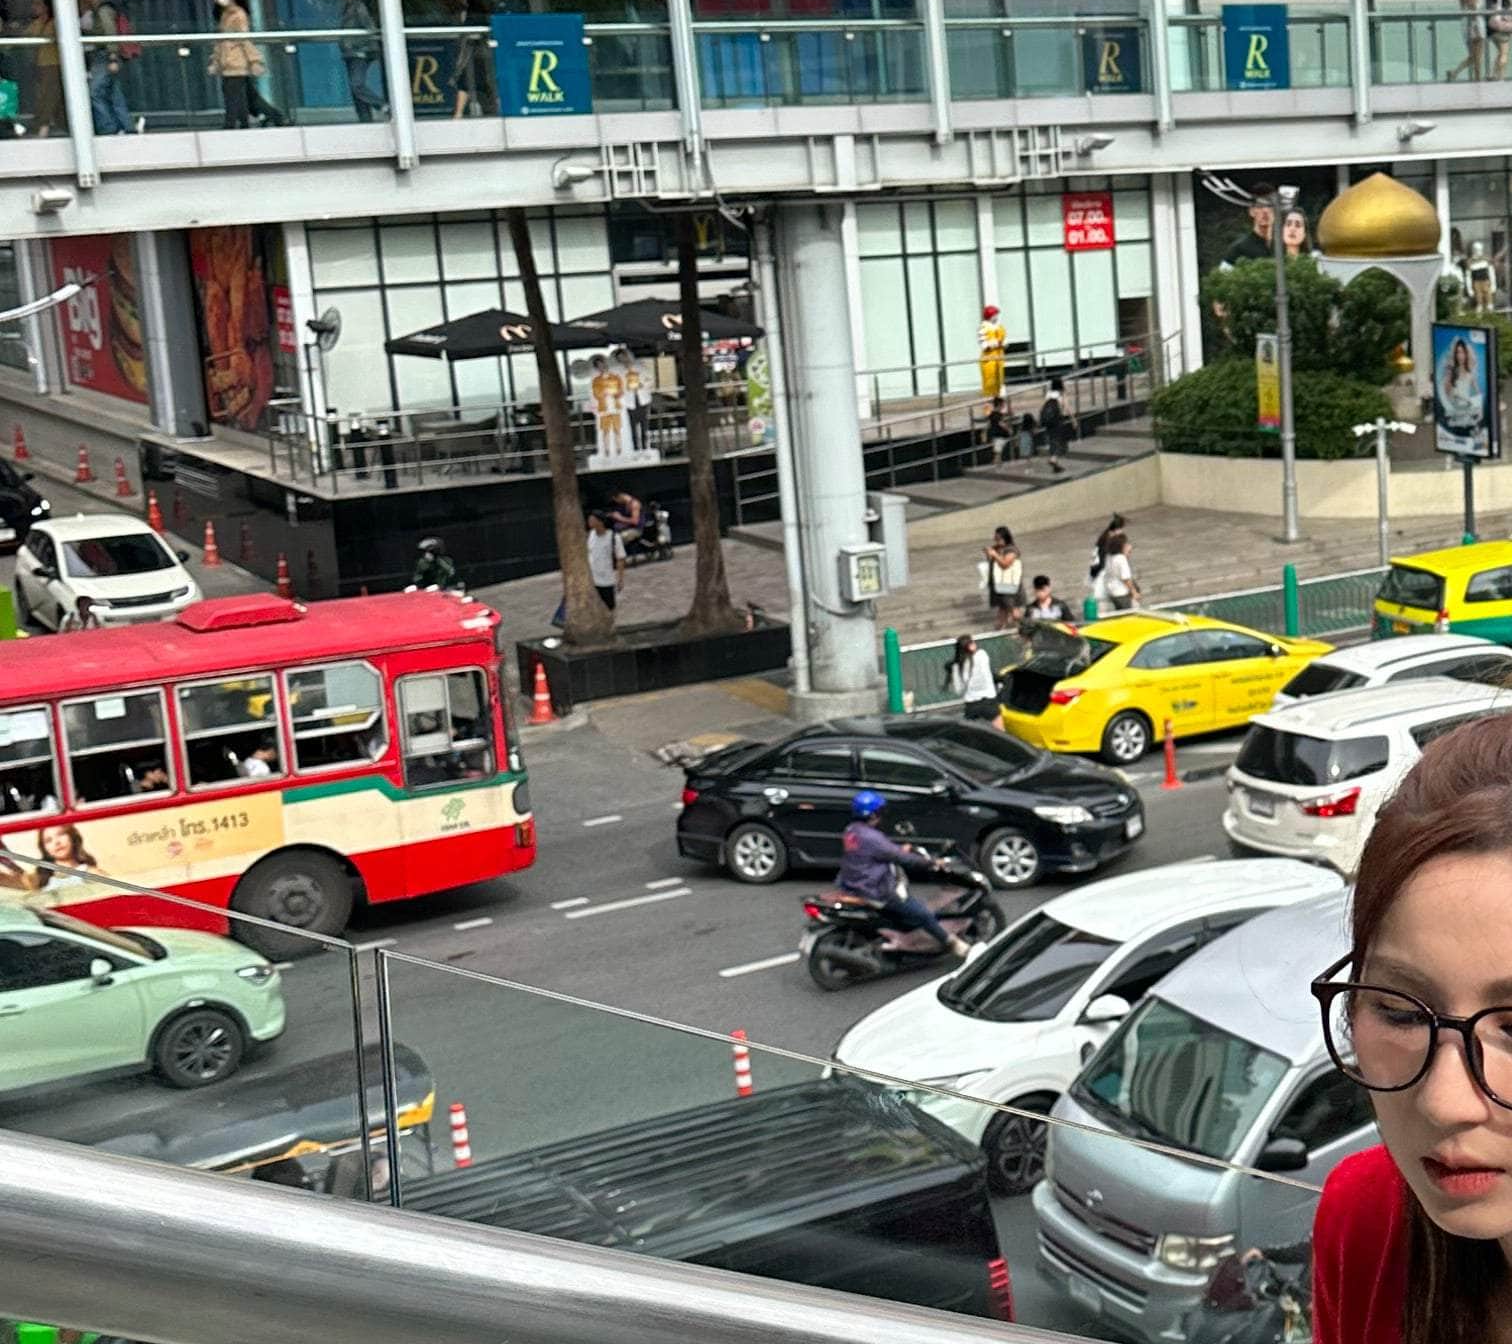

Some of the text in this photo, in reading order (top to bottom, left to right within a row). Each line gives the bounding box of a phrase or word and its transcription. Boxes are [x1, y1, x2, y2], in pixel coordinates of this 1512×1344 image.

[528, 49, 561, 92] R
[1246, 34, 1269, 70] R
[413, 55, 442, 95] R
[527, 91, 565, 103] WALK
